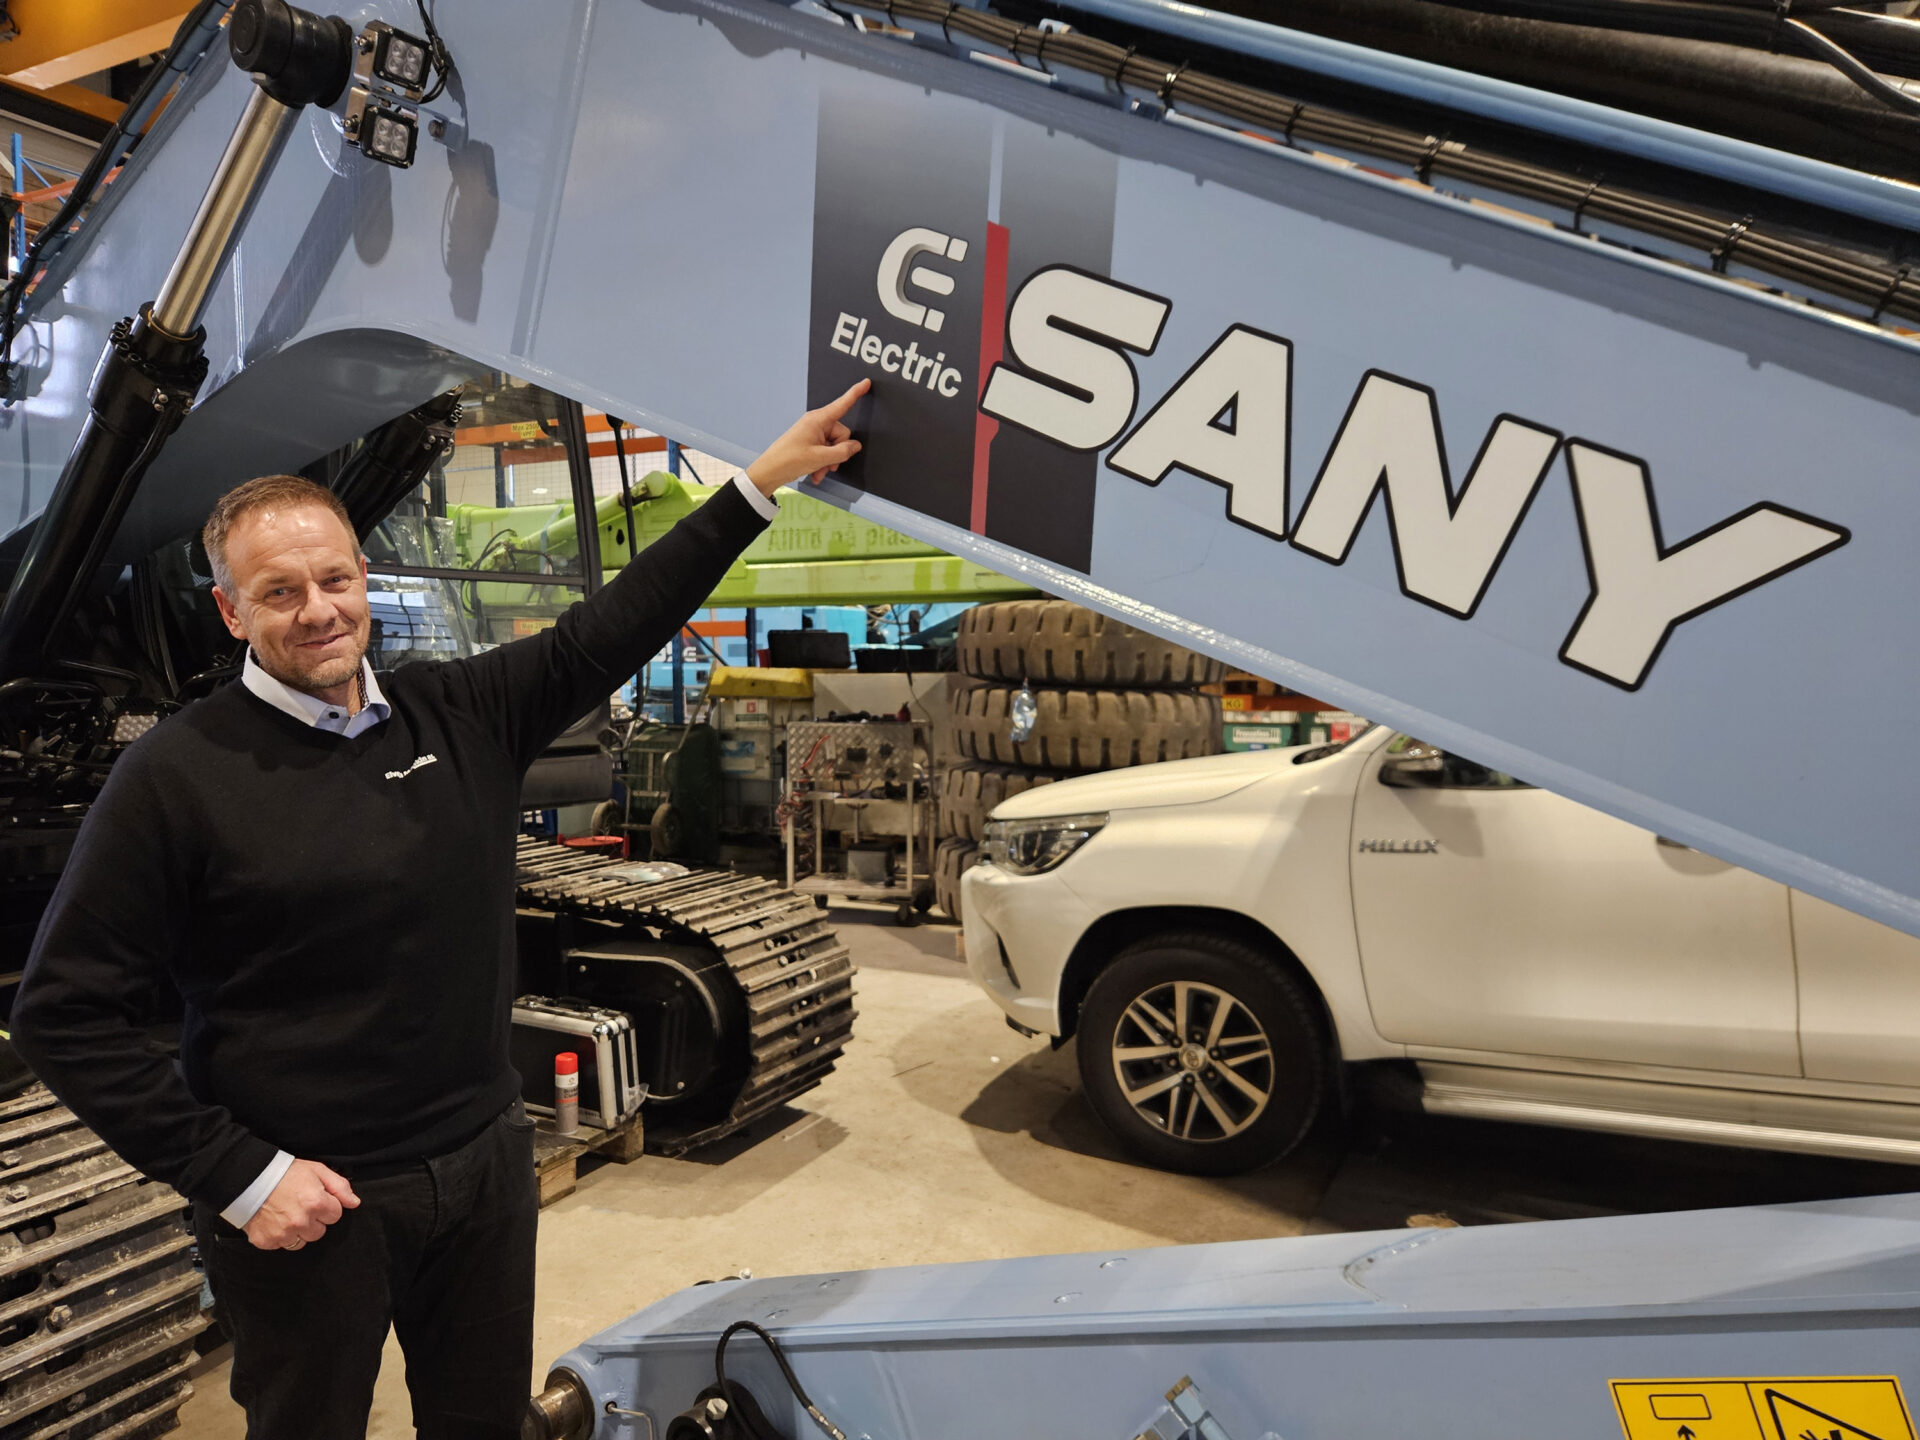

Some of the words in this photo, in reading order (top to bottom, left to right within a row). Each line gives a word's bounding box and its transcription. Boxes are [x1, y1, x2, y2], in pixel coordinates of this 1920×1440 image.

[830, 311, 963, 398] Electric
[977, 263, 1852, 692] SANY
[1358, 838, 1439, 854] HILUX
